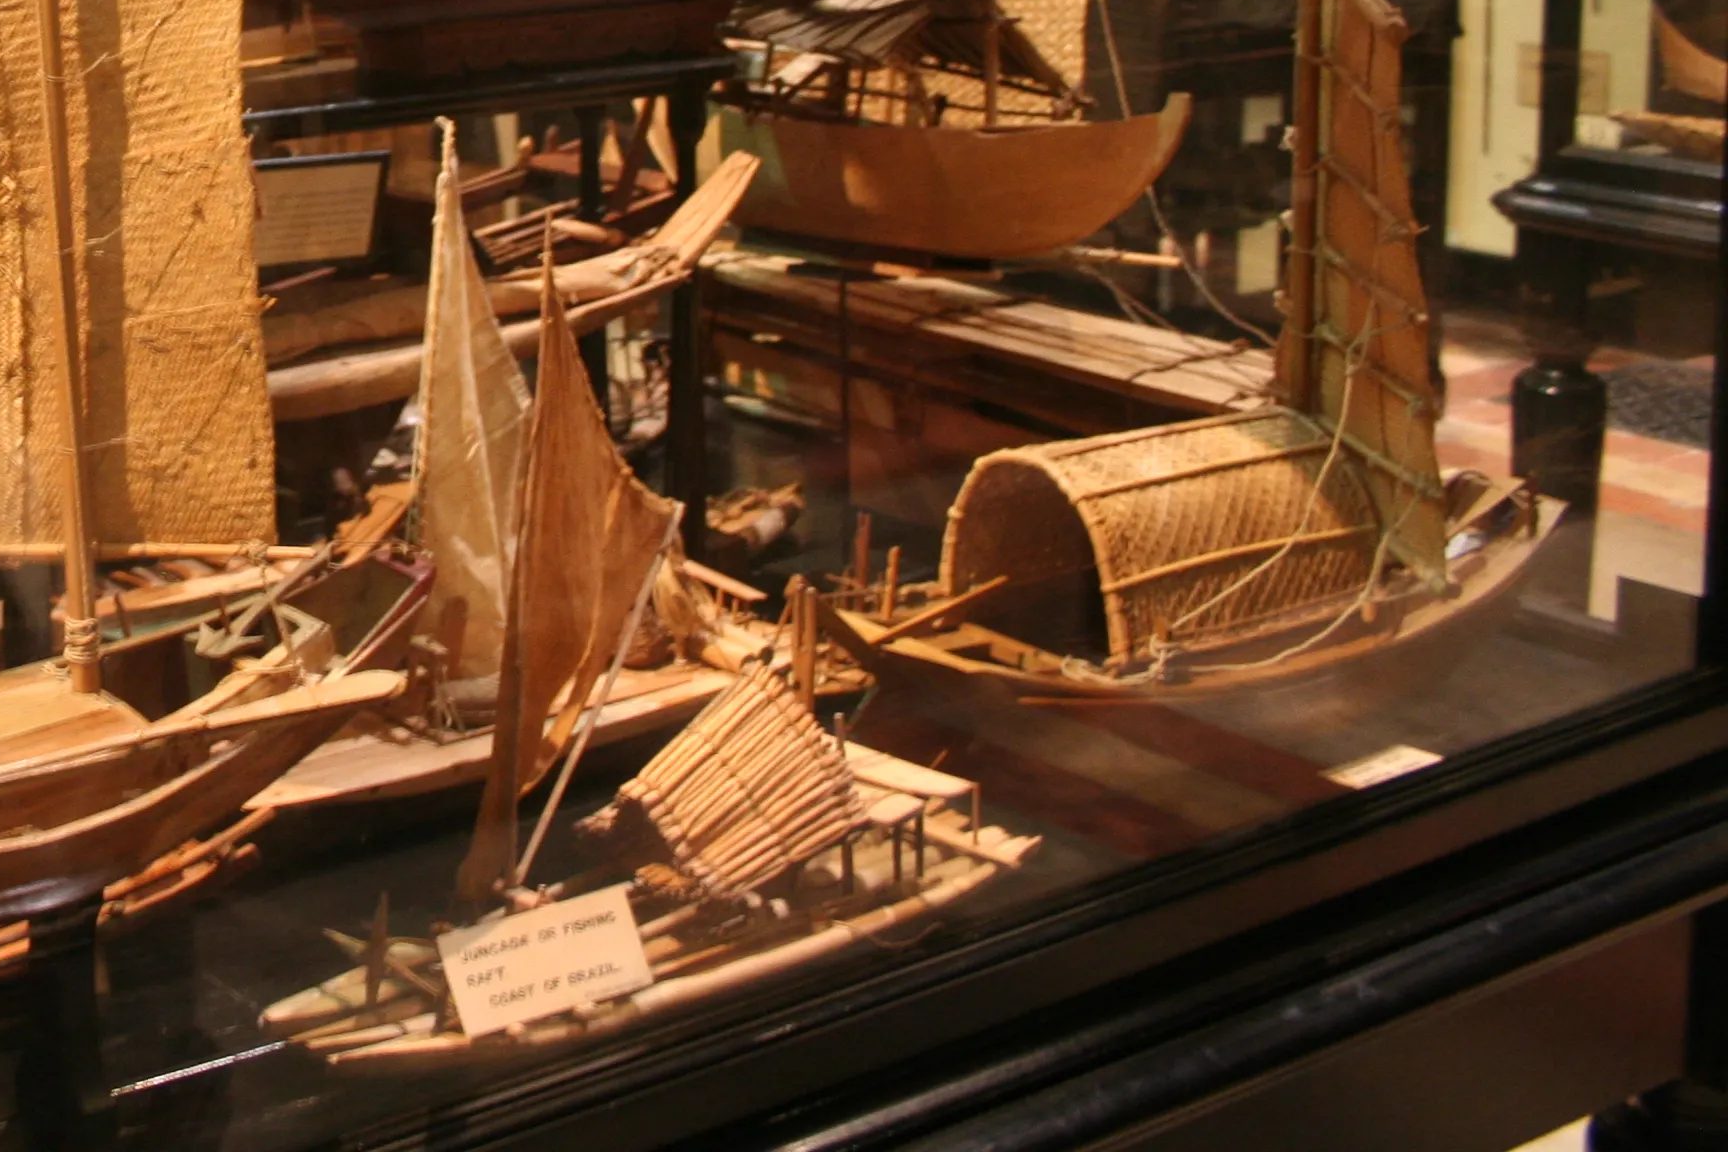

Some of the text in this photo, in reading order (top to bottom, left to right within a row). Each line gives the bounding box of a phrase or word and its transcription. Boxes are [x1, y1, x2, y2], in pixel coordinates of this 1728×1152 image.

[562, 910, 617, 936] FISHING
[466, 965, 505, 987] RAFT
[489, 983, 535, 1008] COAST
[543, 976, 561, 993] OF
